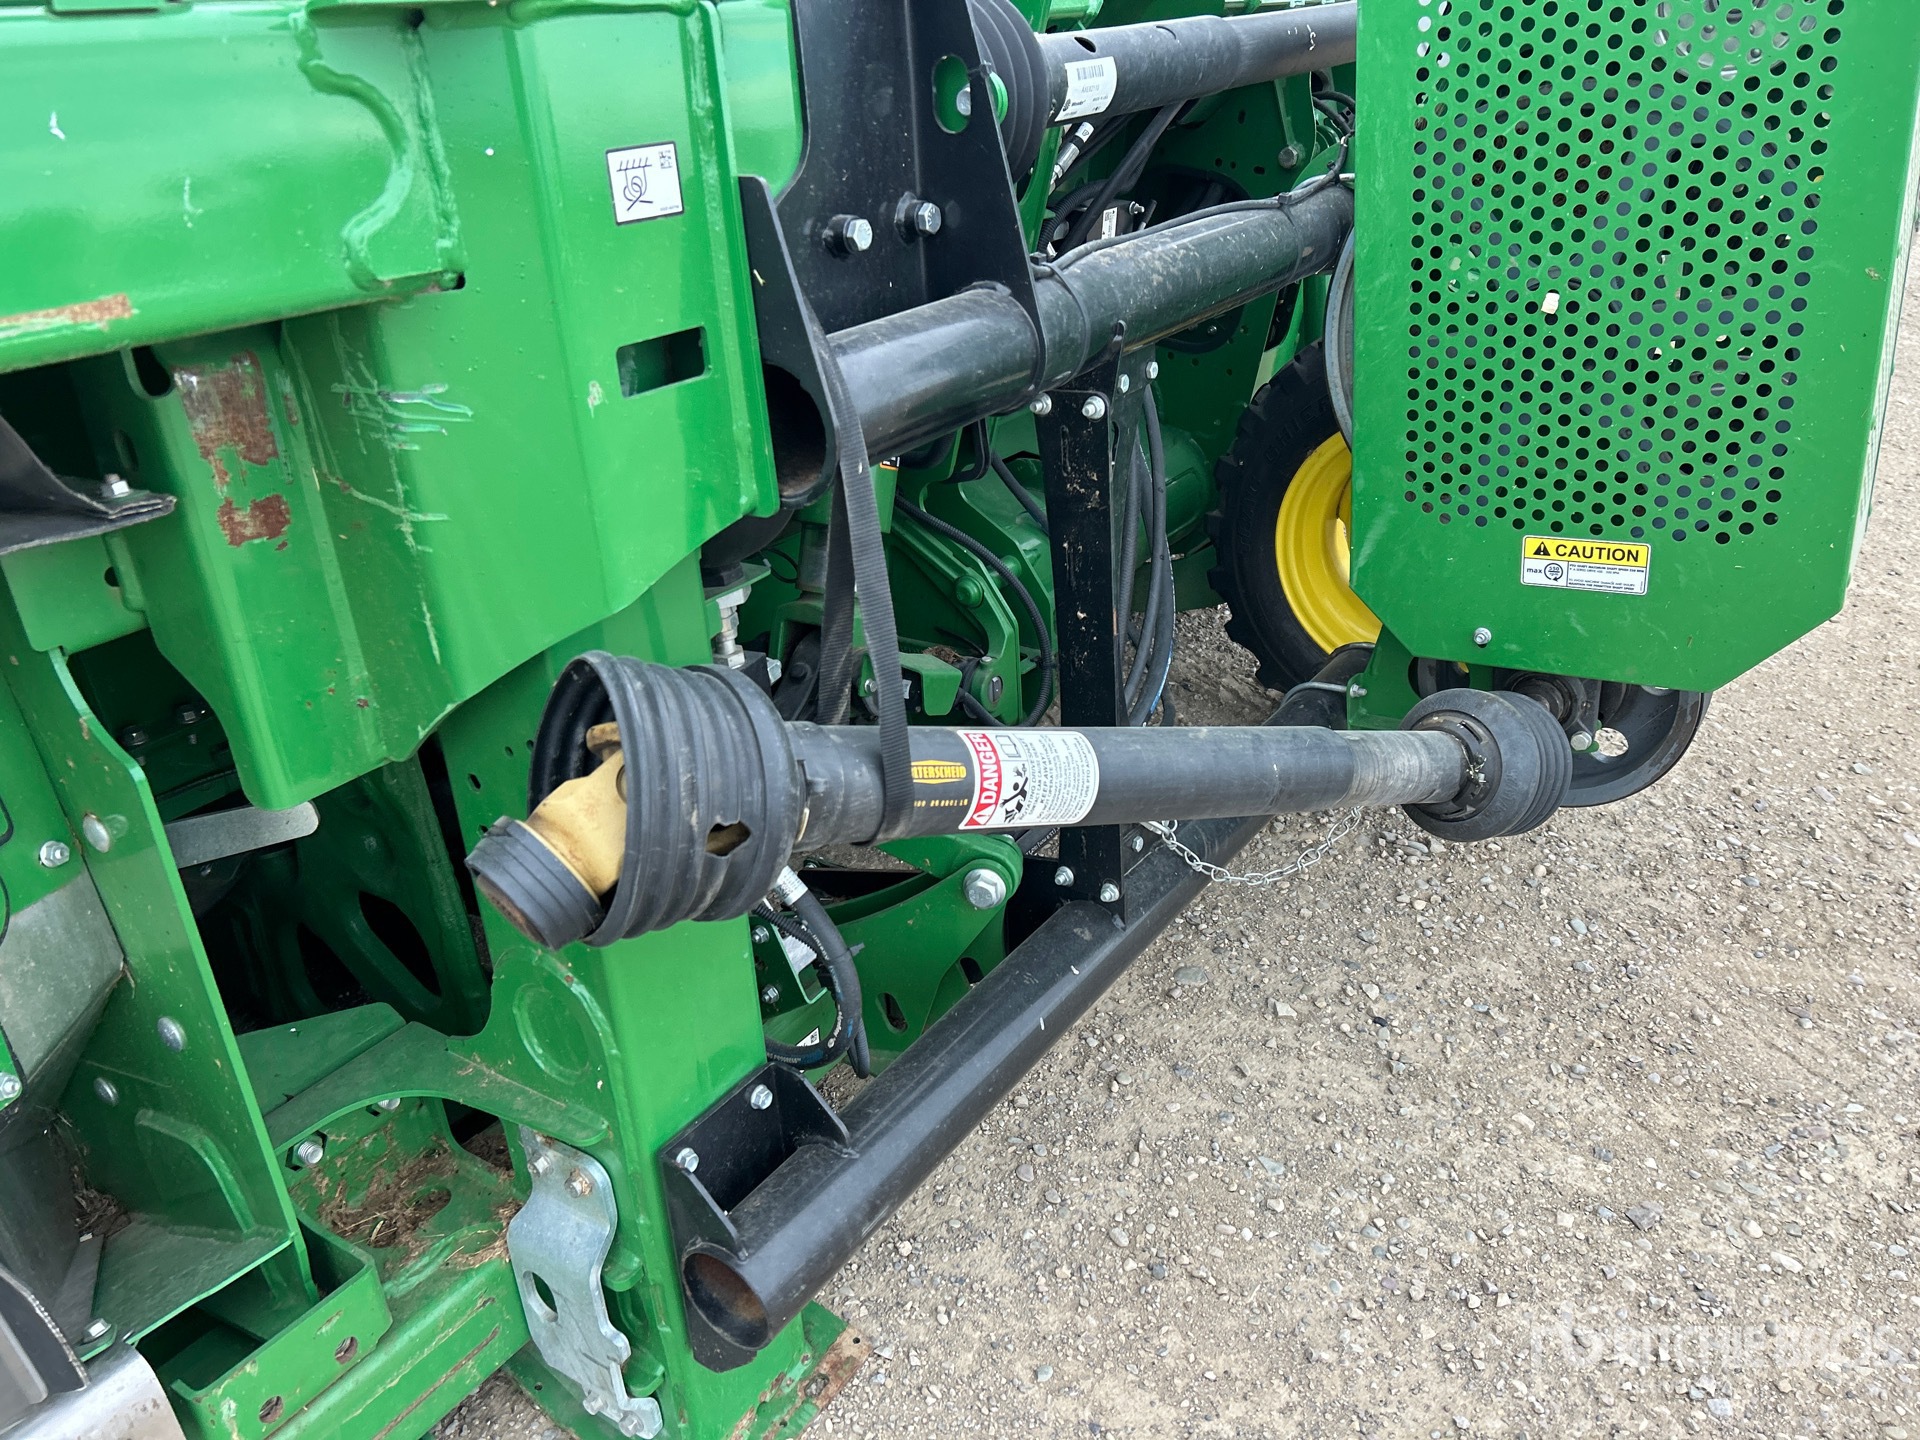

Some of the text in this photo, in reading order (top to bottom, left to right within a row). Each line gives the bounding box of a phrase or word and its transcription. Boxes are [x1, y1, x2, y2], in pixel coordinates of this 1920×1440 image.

[1555, 544, 1639, 562] CAUTION
[968, 733, 998, 804] DANGER
[1039, 780, 1047, 803] KEEP
